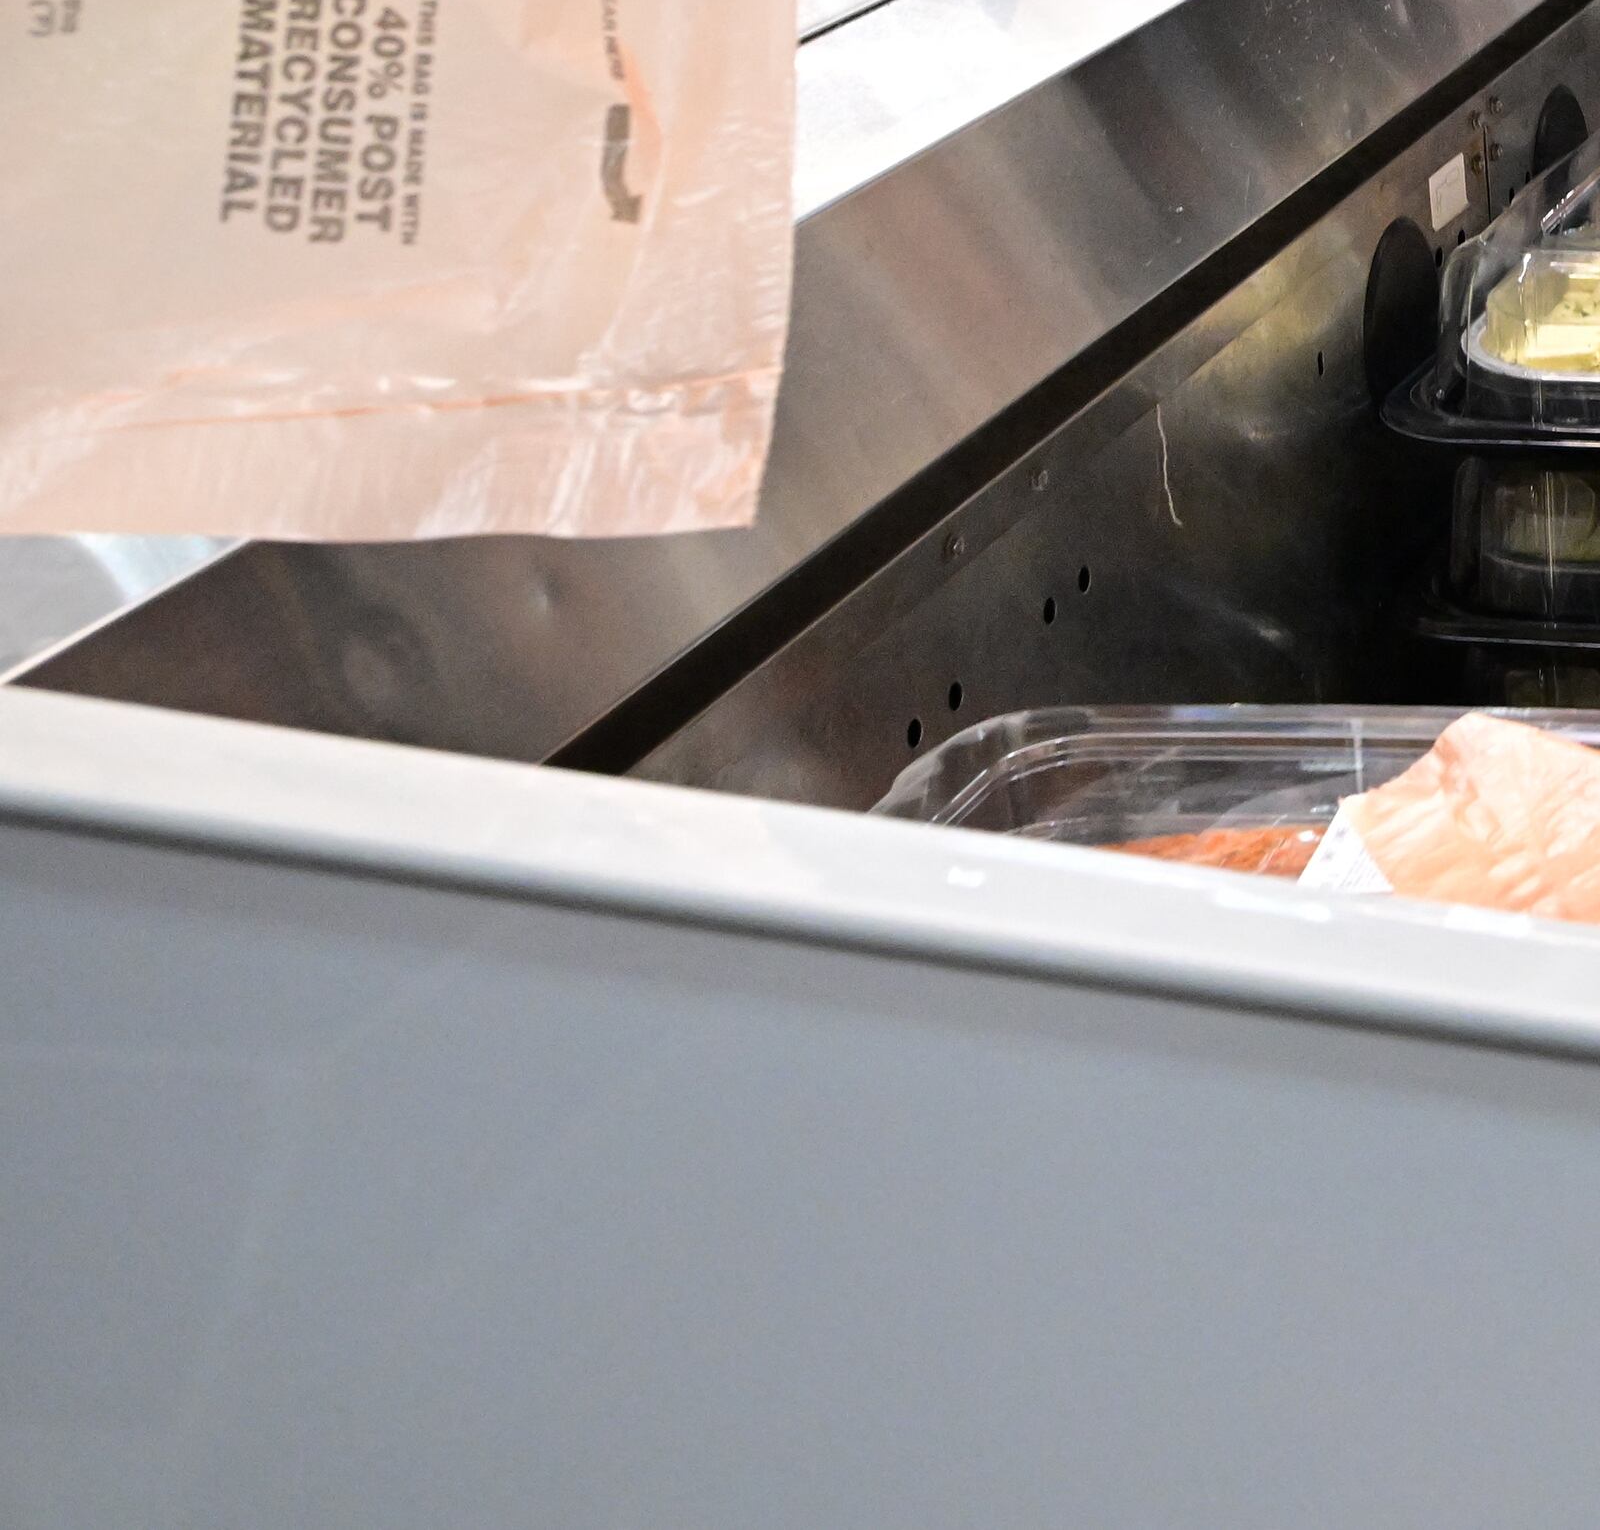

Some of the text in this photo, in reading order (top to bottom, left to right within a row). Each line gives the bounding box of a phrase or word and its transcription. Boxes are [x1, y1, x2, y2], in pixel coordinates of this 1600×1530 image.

[411, 53, 433, 95] BAG
[354, 6, 408, 232] 40% POST
[408, 102, 428, 121] IS
[402, 128, 426, 186] MADE
[400, 192, 420, 246] WITH
